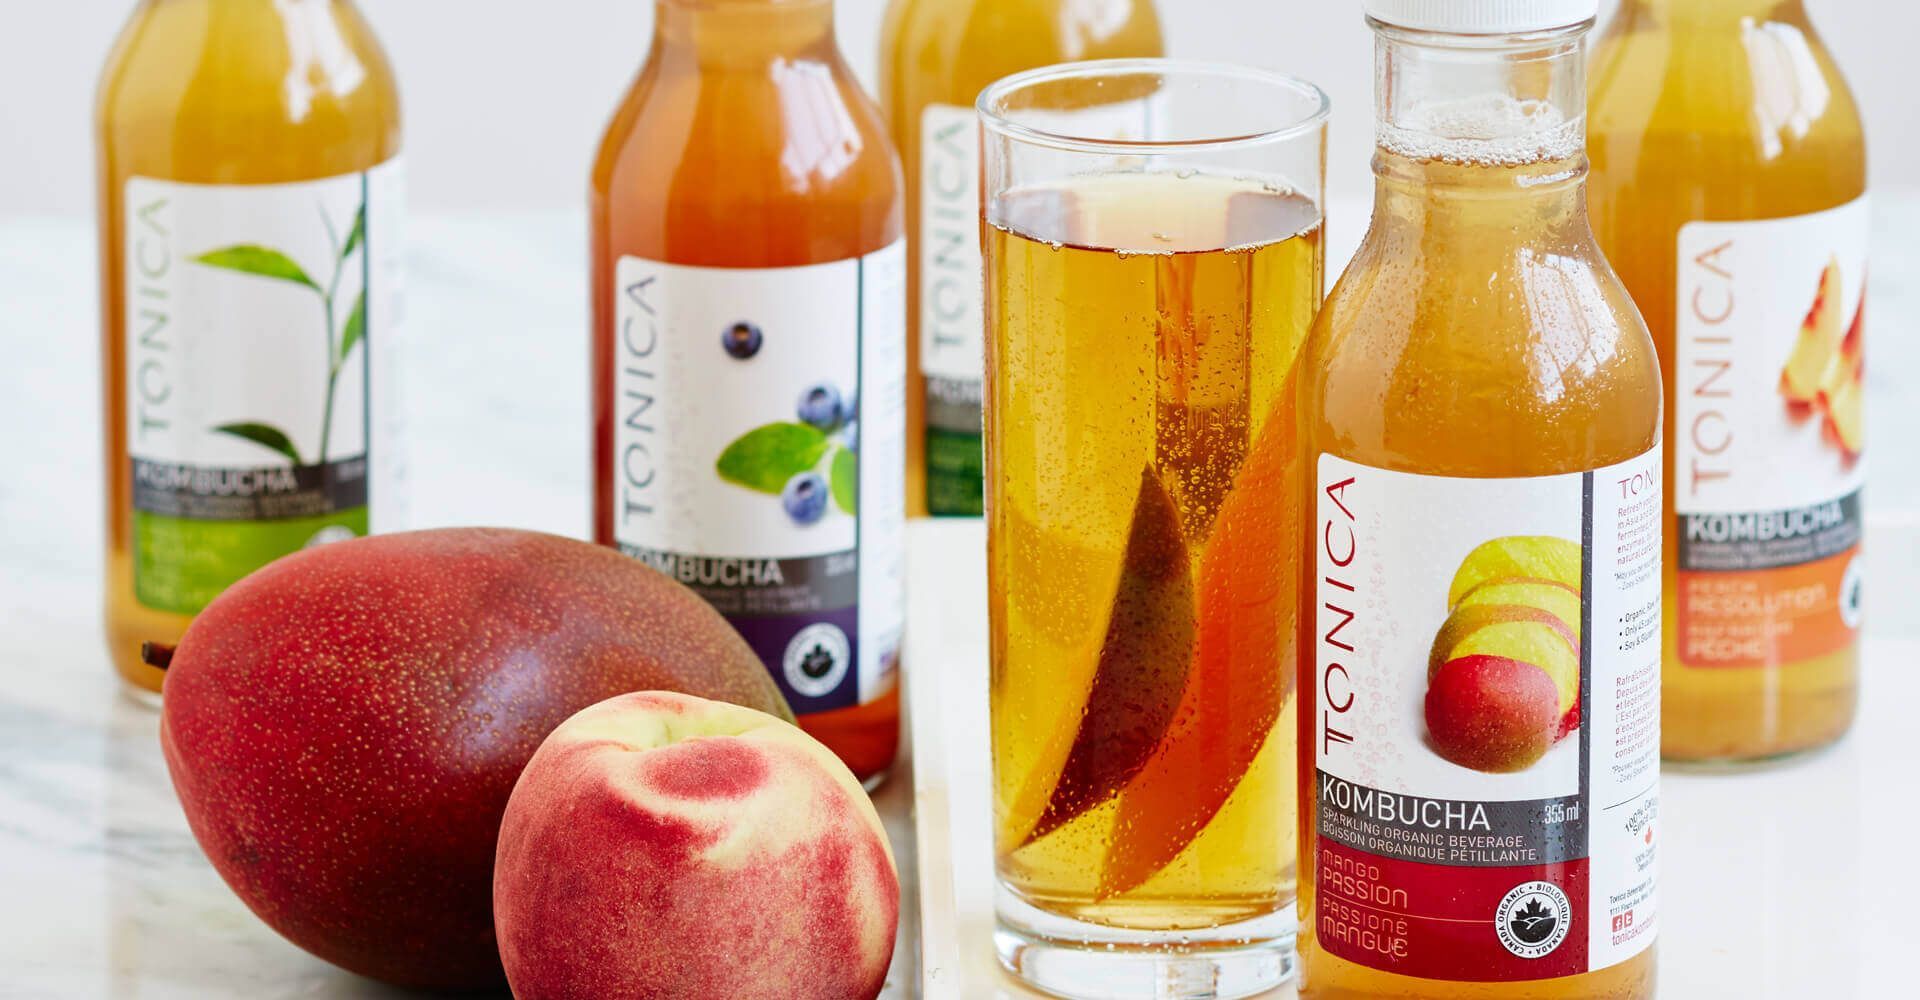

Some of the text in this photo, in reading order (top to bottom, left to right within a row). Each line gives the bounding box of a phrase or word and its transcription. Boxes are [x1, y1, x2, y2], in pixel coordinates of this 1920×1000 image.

[933, 119, 968, 356] TONICA
[136, 198, 171, 442] TONICA
[622, 275, 657, 526] TONICA
[1691, 239, 1734, 497] TONICA
[134, 458, 298, 497] KOMBUCHA
[1686, 497, 1844, 543] KOMBUCHA
[1324, 476, 1356, 757] TONICA
[1323, 773, 1491, 832] KOMBUCHA
[1323, 806, 1380, 837] SPARKLING
[1384, 826, 1444, 846] ORGANIC
[1544, 801, 1579, 825] 355 ml
[1323, 819, 1537, 862] BOISSON ORGANIQUE PÉTILLANTE
[1497, 887, 1526, 954] CANADA ORGANIC
[1535, 883, 1569, 955] BIOLOGIQUE CANADA
